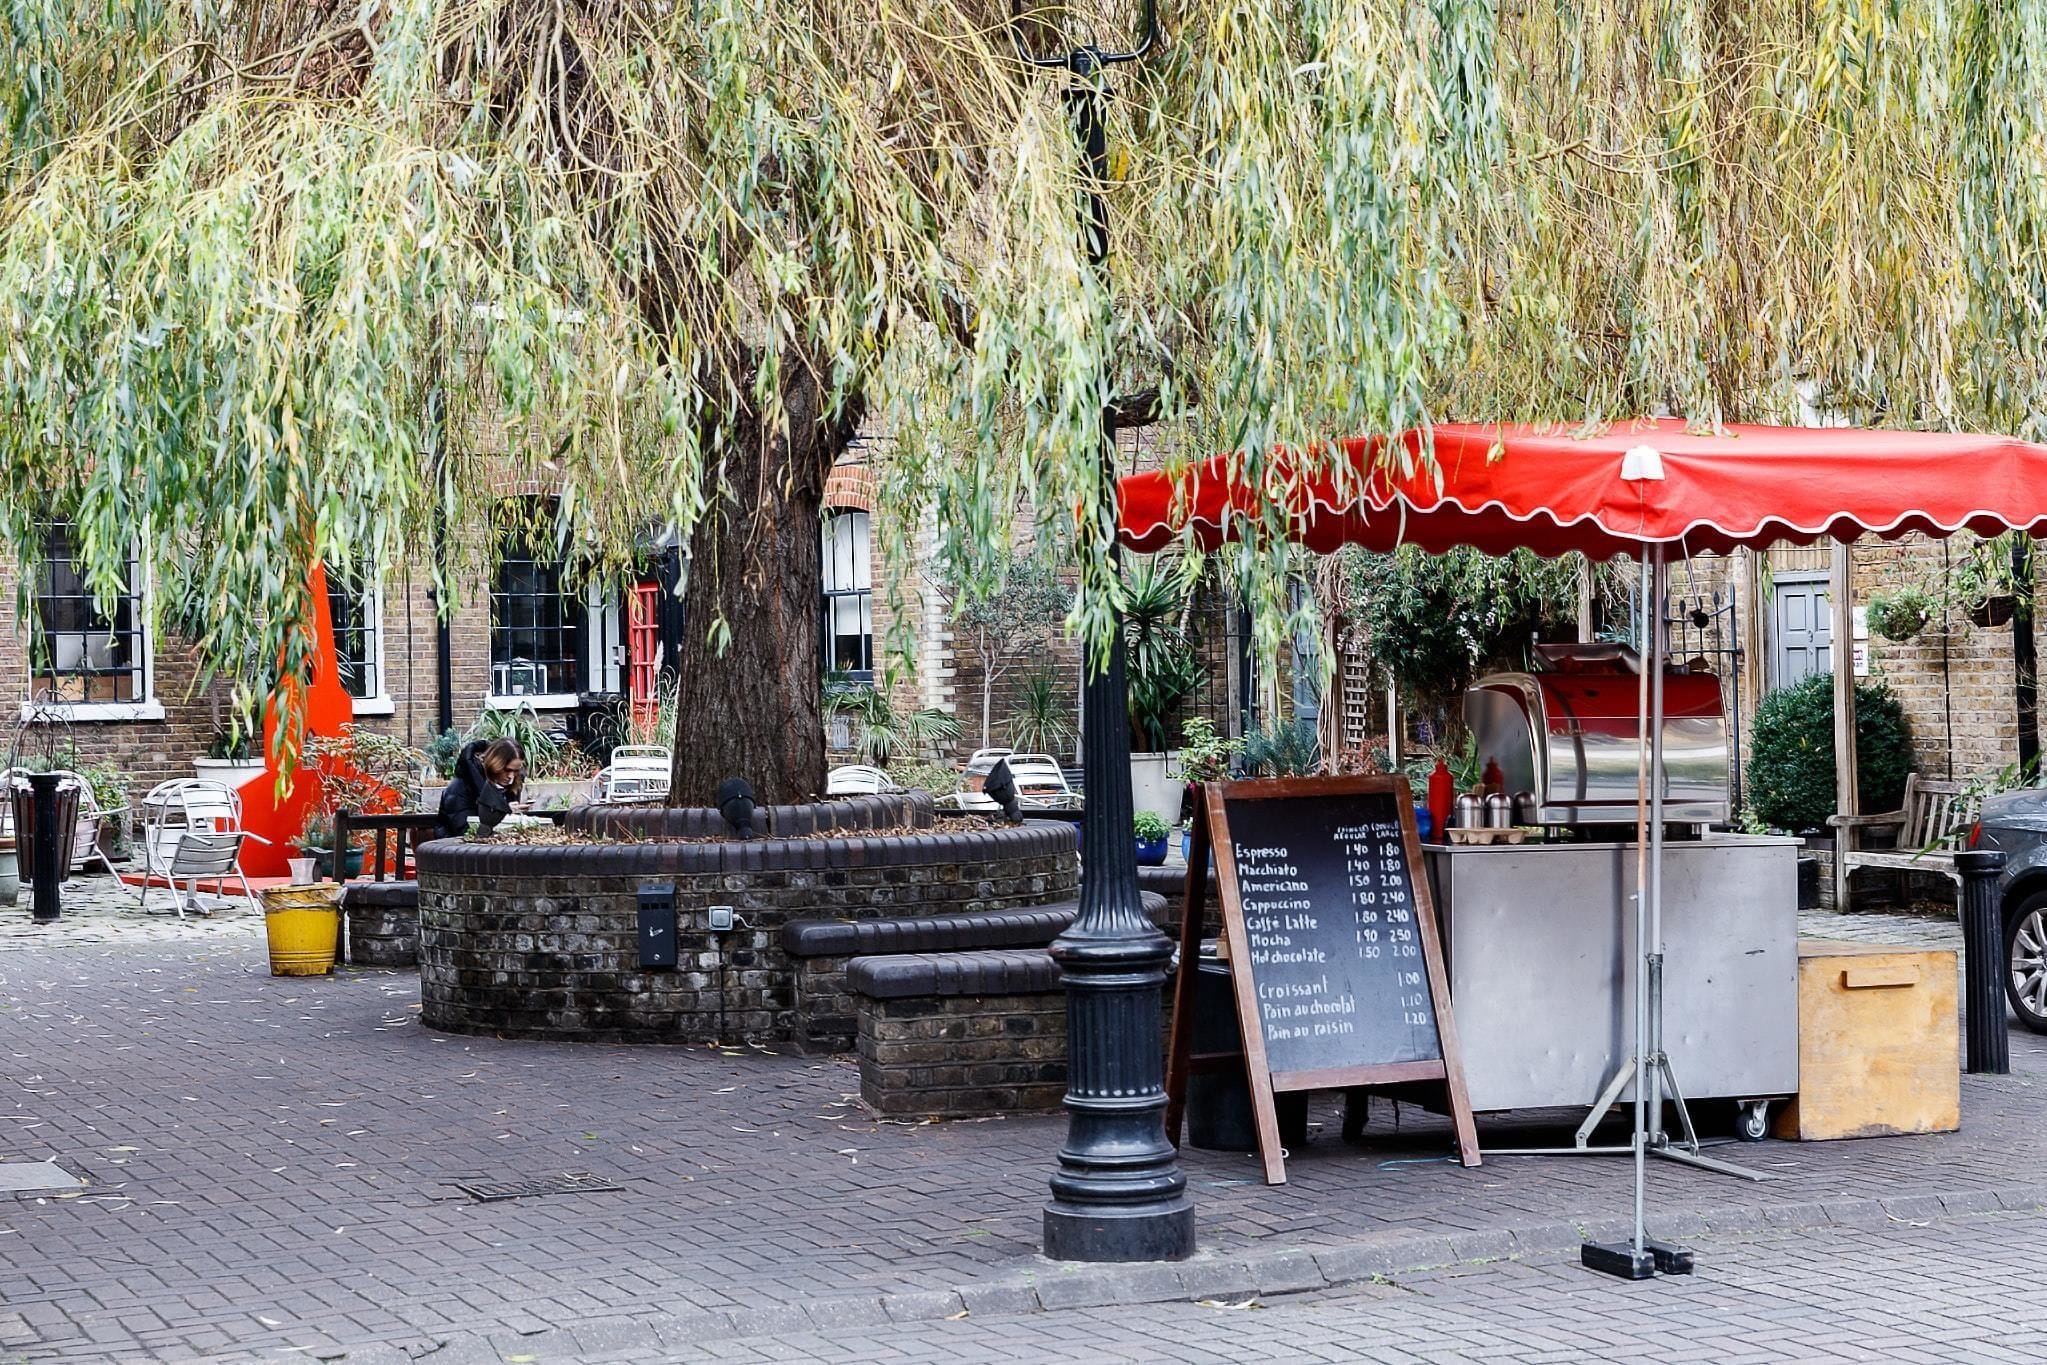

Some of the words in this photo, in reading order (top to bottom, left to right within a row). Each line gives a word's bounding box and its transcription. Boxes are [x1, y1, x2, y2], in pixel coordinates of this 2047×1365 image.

[1236, 843, 1288, 865] Espresso
[1238, 863, 1298, 876] Macchiato
[1242, 879, 1309, 893] Americano
[1242, 897, 1311, 914] Cappuccino
[1285, 913, 1318, 930] Latte
[1251, 934, 1292, 947] Mocha
[1271, 947, 1327, 964] chocolate
[1258, 974, 1329, 999] Croissant
[1397, 971, 1420, 987] 1.00
[1263, 1003, 1291, 1020] Pain
[1400, 992, 1423, 1008] 1.10
[1267, 1024, 1291, 1041] Pain
[1293, 1026, 1309, 1038] au
[1314, 1019, 1354, 1037] raisin
[1404, 1011, 1427, 1025] 1.20
